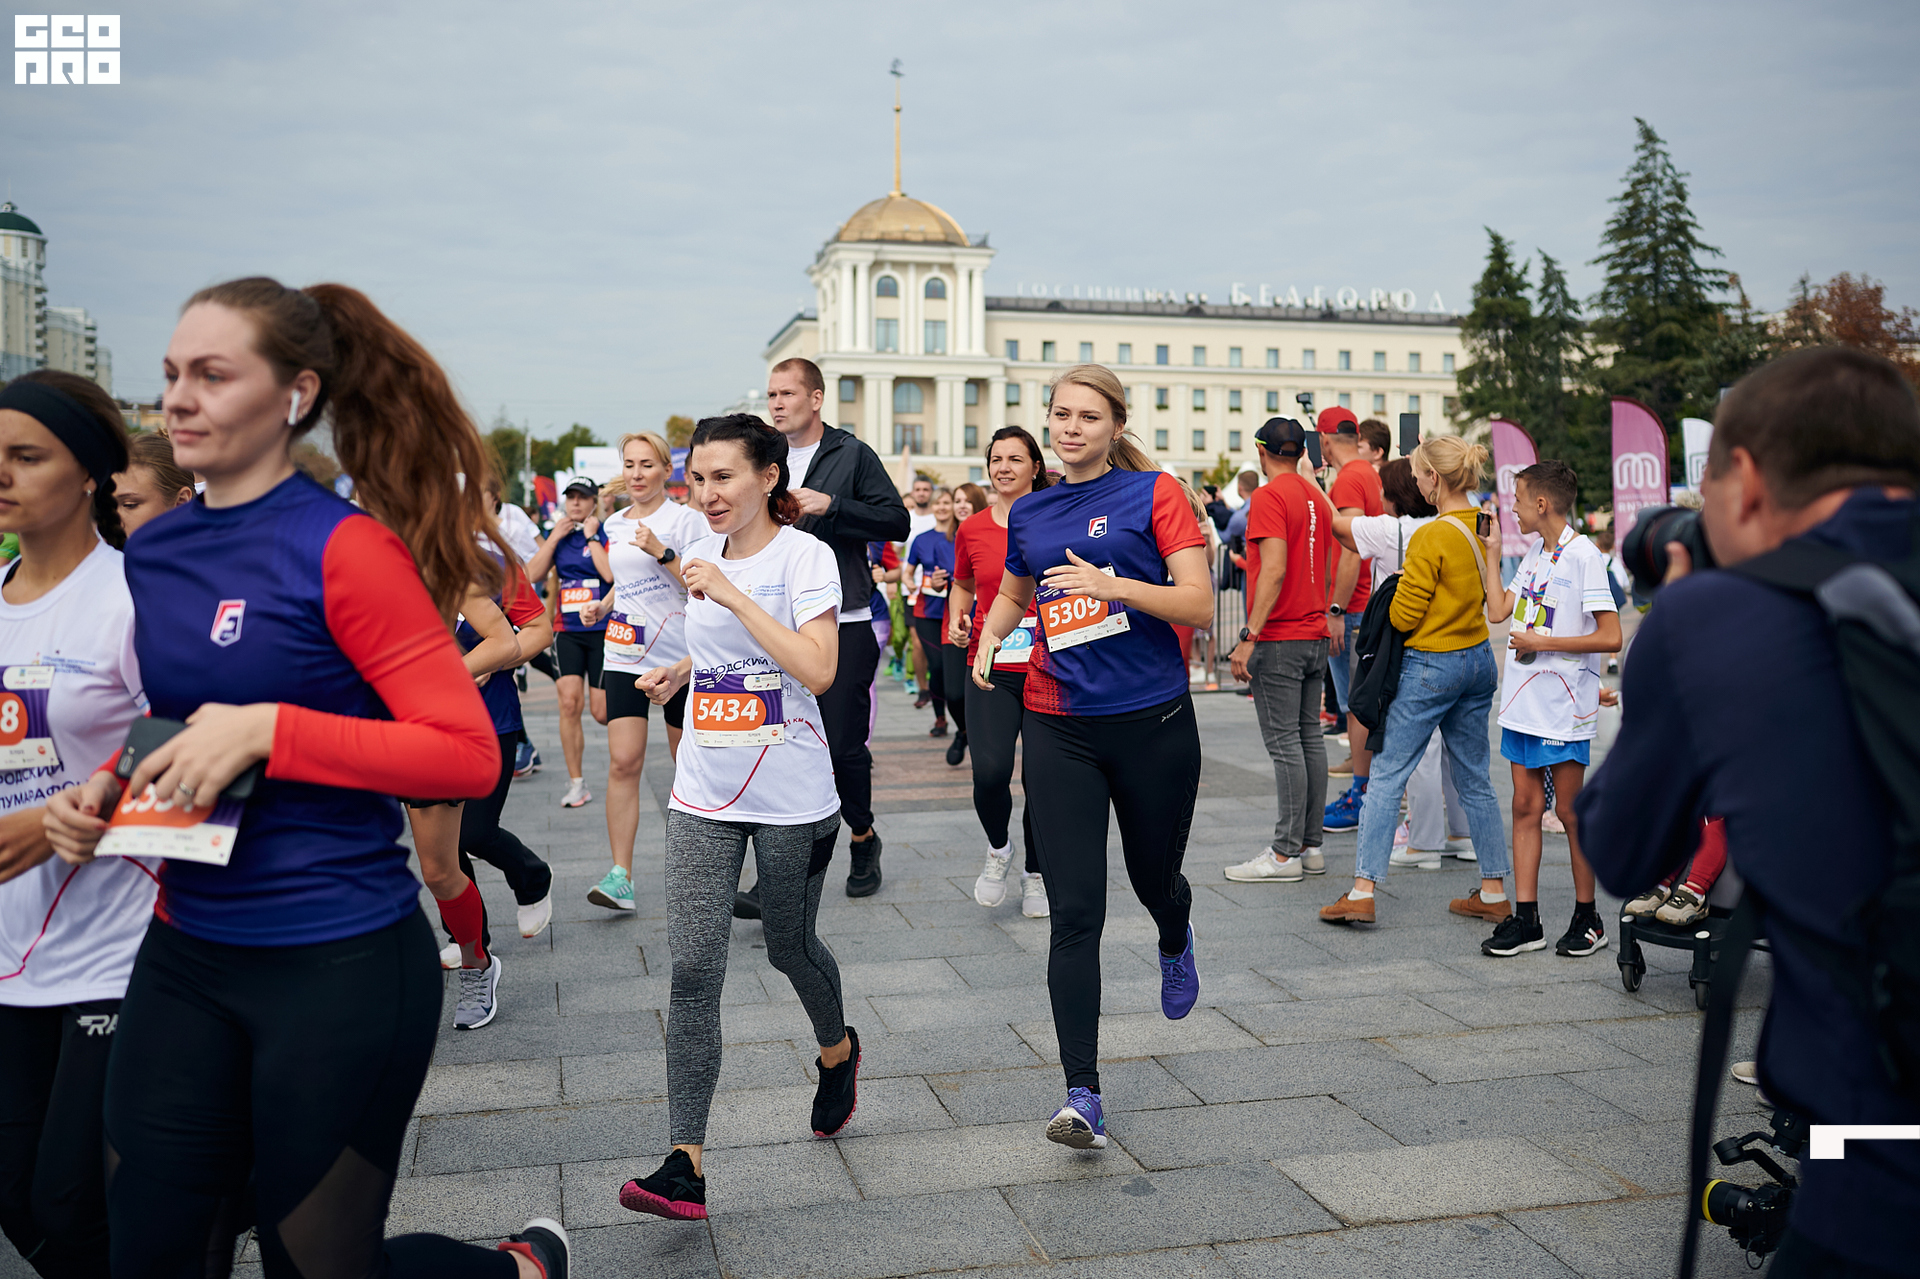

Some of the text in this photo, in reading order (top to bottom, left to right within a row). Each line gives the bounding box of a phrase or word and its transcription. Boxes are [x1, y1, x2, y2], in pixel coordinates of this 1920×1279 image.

[564, 589, 591, 603] 5469
[1048, 597, 1101, 628] 5309
[607, 623, 632, 640] 5036
[697, 698, 758, 721] 5434
